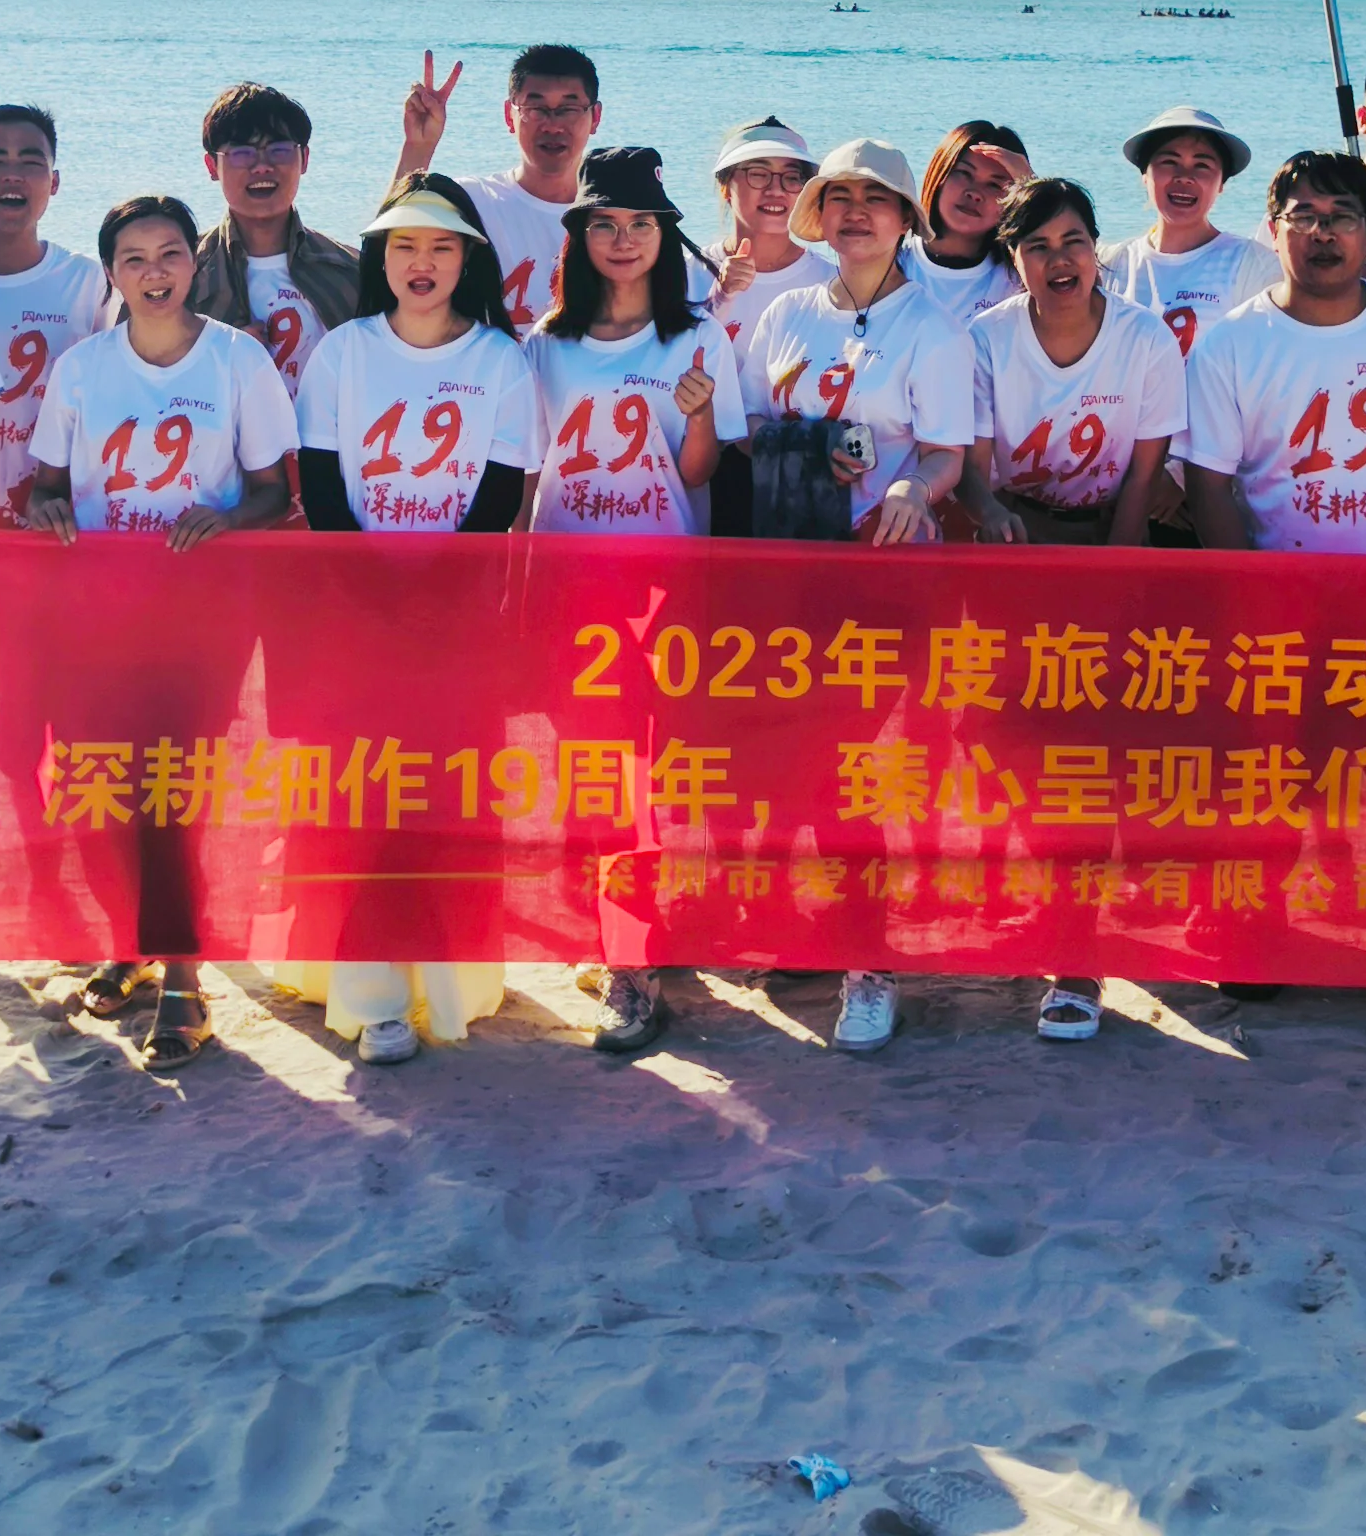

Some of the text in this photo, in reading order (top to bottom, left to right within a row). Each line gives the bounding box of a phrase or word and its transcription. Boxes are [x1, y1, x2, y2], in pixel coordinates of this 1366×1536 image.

[267, 306, 303, 370] 9
[1163, 306, 1198, 359] 9
[102, 414, 193, 495] 19
[361, 398, 478, 480] 19 周年
[558, 392, 650, 480] 19
[1011, 412, 1106, 486] 19
[104, 498, 196, 531] 深耕细
[363, 482, 467, 528] 深耕细作
[562, 480, 669, 522] 深耕细作
